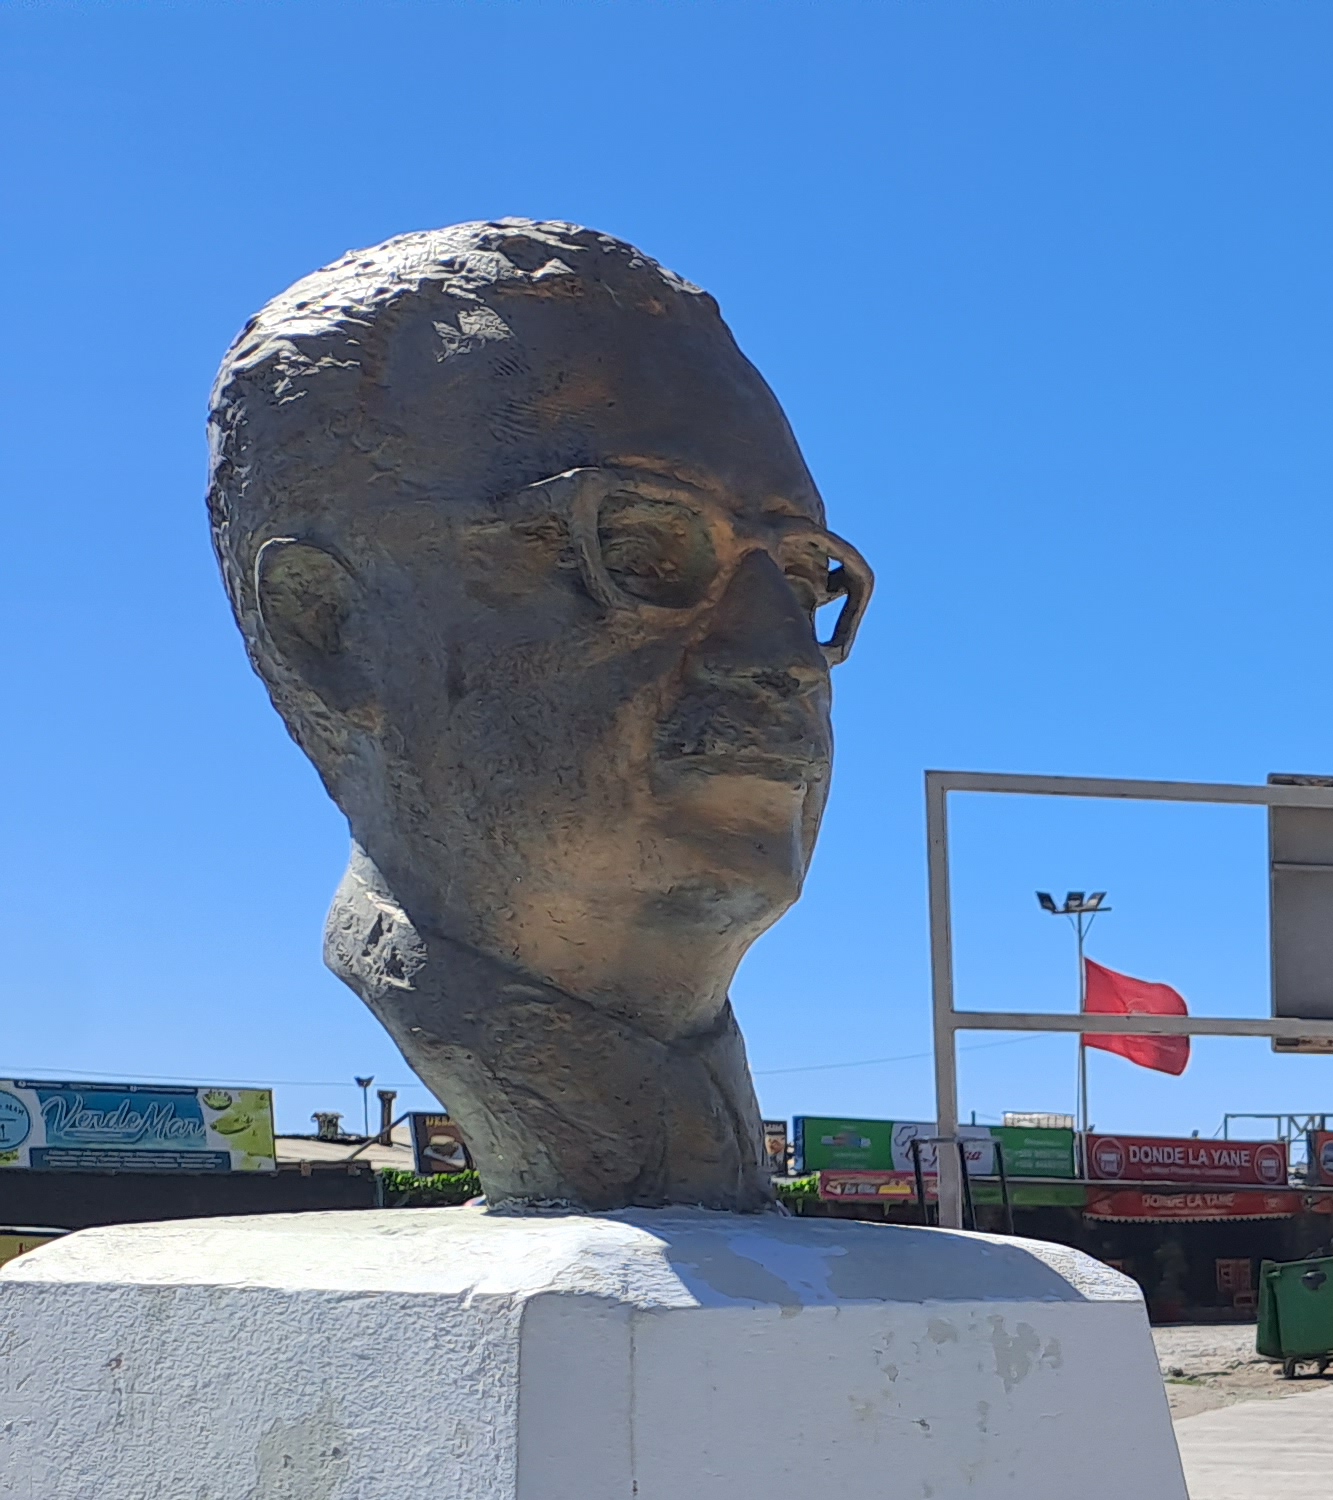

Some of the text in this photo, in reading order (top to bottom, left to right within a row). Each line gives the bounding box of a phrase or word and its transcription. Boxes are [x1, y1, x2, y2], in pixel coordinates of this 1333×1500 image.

[1128, 1145, 1250, 1167] DONDE LA YANE
